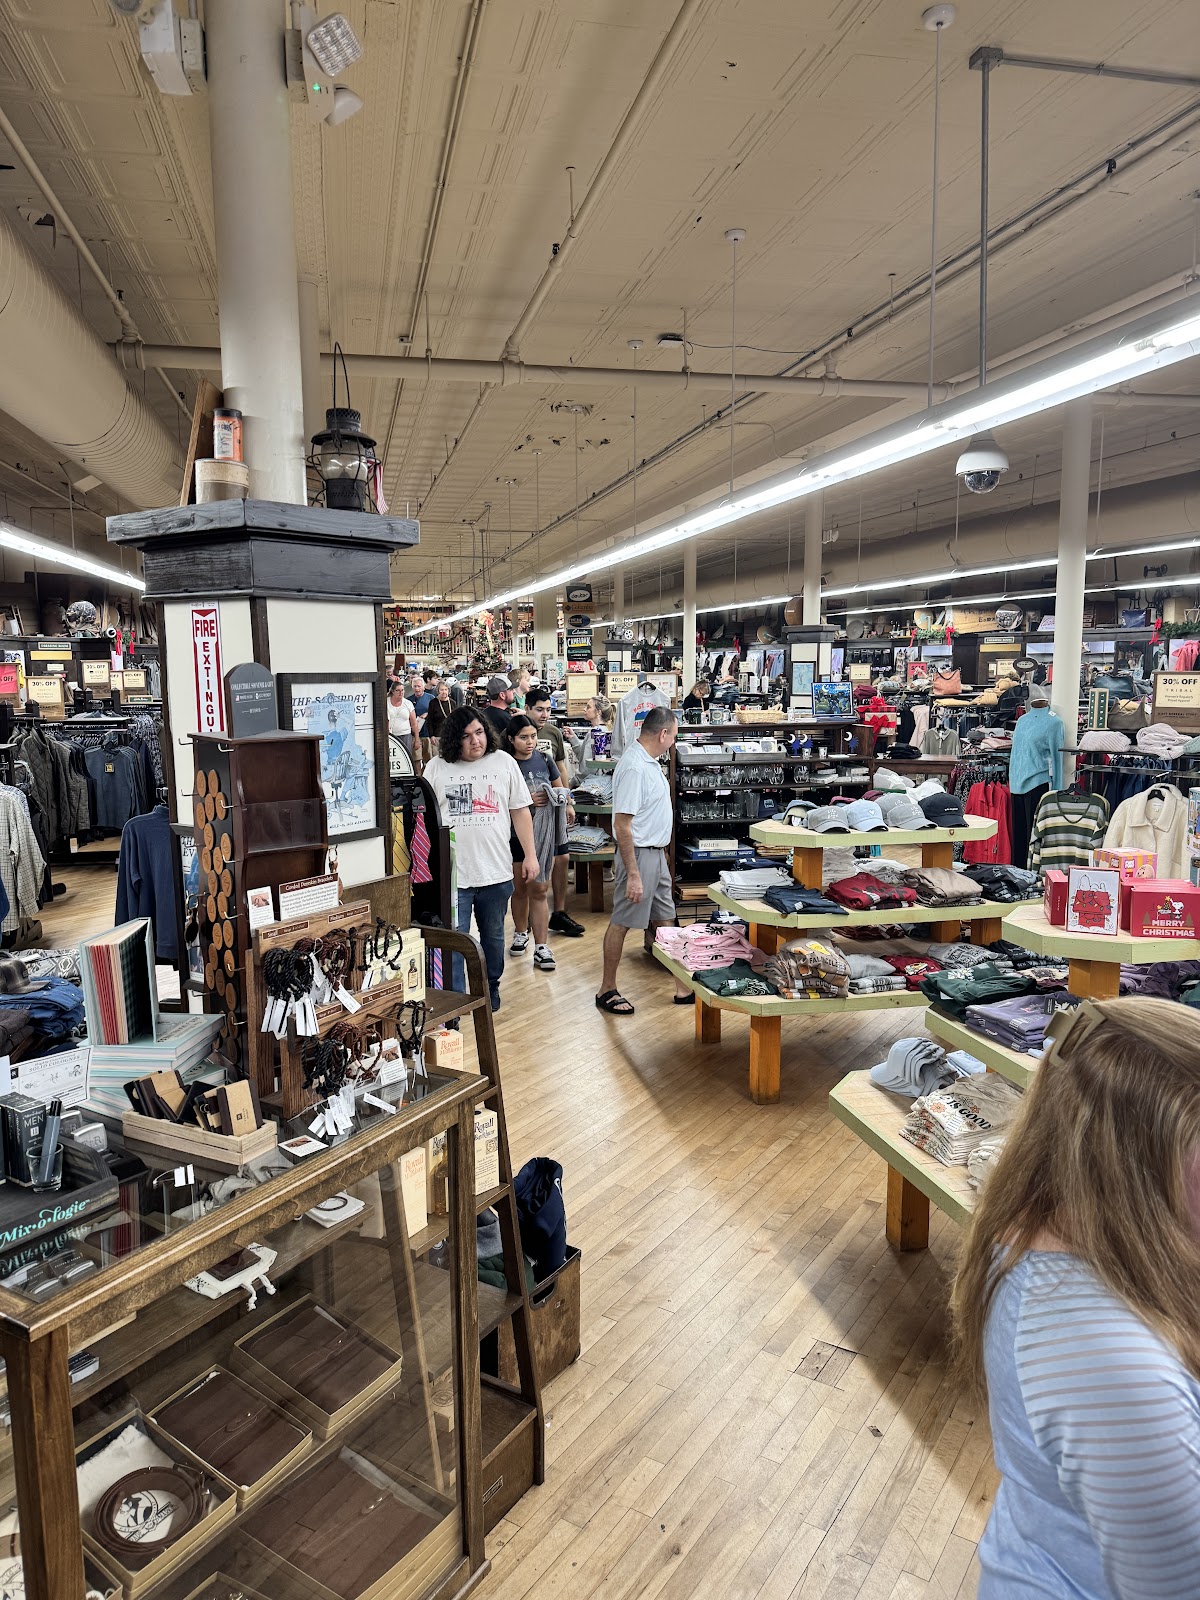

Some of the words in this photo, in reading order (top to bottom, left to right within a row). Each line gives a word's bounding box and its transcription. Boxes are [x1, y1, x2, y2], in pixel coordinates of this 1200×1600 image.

[195, 619, 216, 638] FIRE
[450, 774, 498, 782] TOMMY
[451, 816, 497, 824] HILFIGER
[1151, 919, 1185, 927] MERRY
[1142, 928, 1196, 937] CHRISTMAS
[29, 1063, 48, 1072] SOLID
[48, 1056, 80, 1067] COLOGNES
[24, 1114, 44, 1128] MEN
[958, 1108, 992, 1130] GOOD
